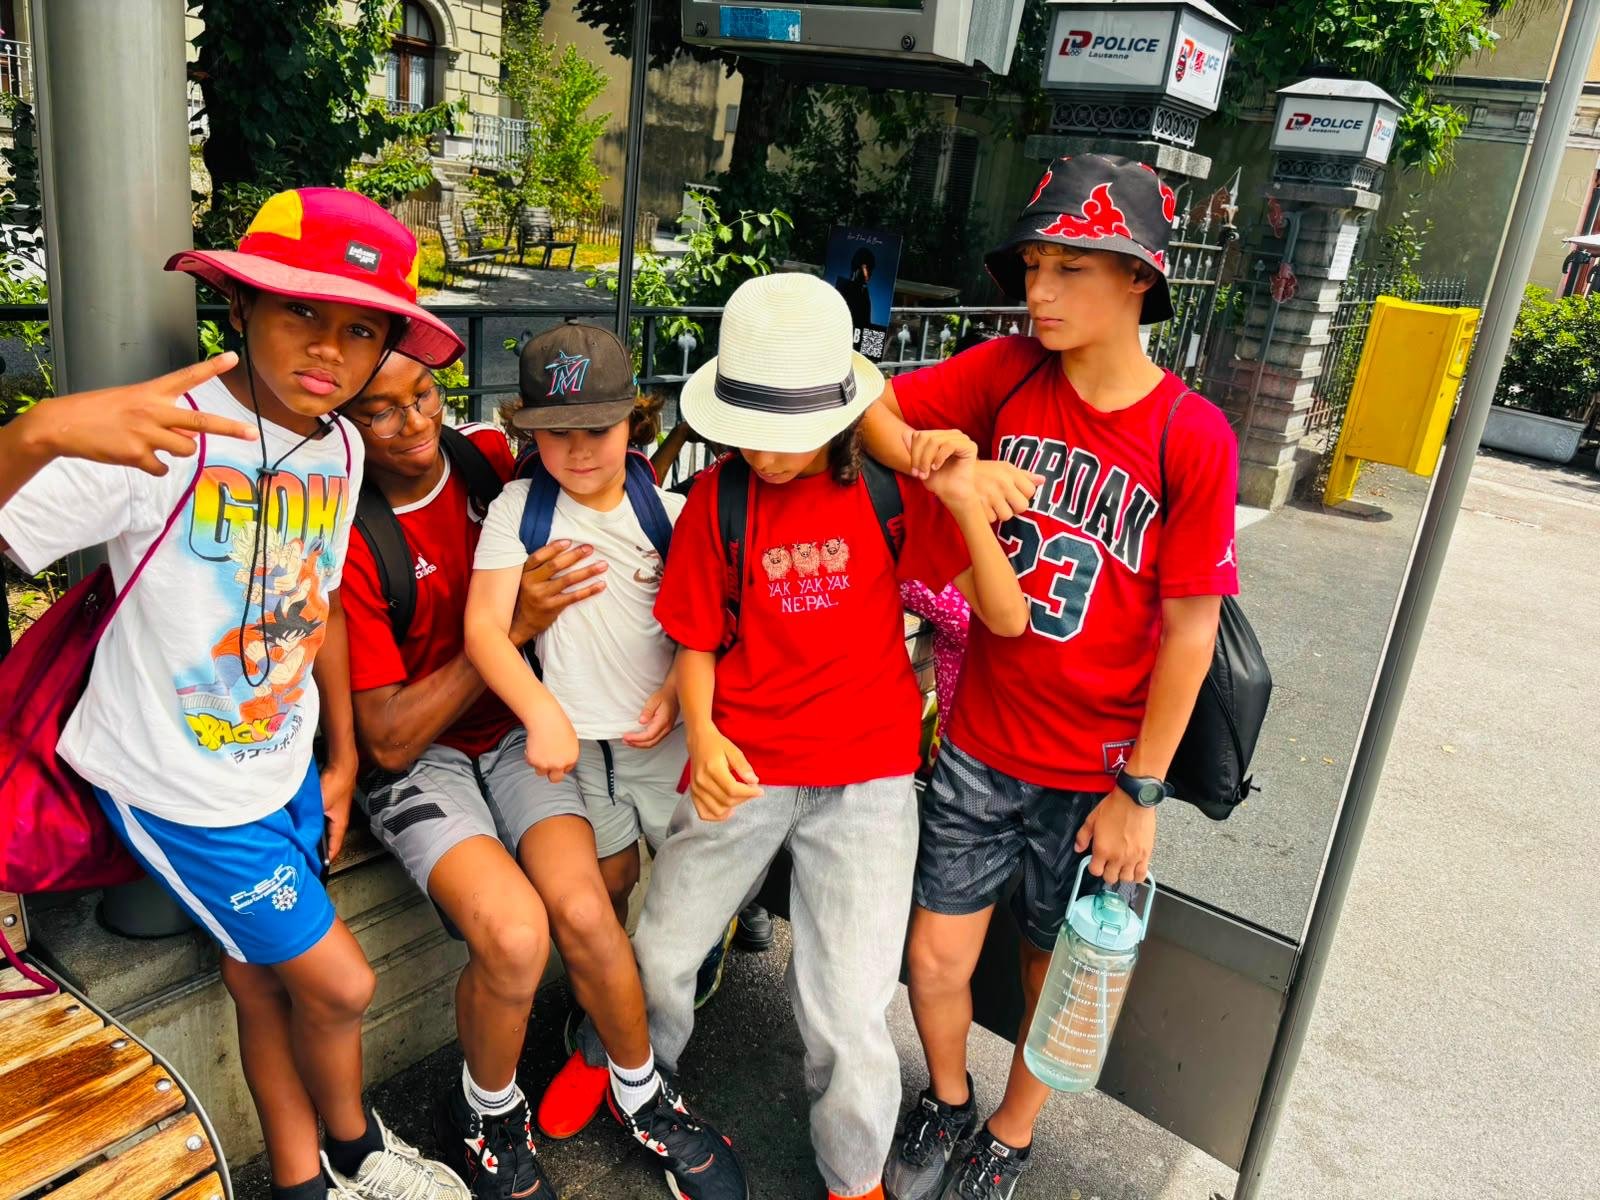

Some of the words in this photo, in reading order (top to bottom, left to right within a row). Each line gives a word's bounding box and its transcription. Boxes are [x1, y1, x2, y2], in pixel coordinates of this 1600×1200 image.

[1091, 36, 1160, 53] POLICE
[1088, 50, 1129, 60] Lausanne
[1311, 117, 1364, 130] POLICE
[189, 464, 350, 563] GOK
[767, 581, 791, 598] YAK
[797, 577, 824, 594] YAK
[825, 574, 851, 591] YAK
[998, 514, 1104, 643] 23
[780, 593, 839, 613] NEPAL
